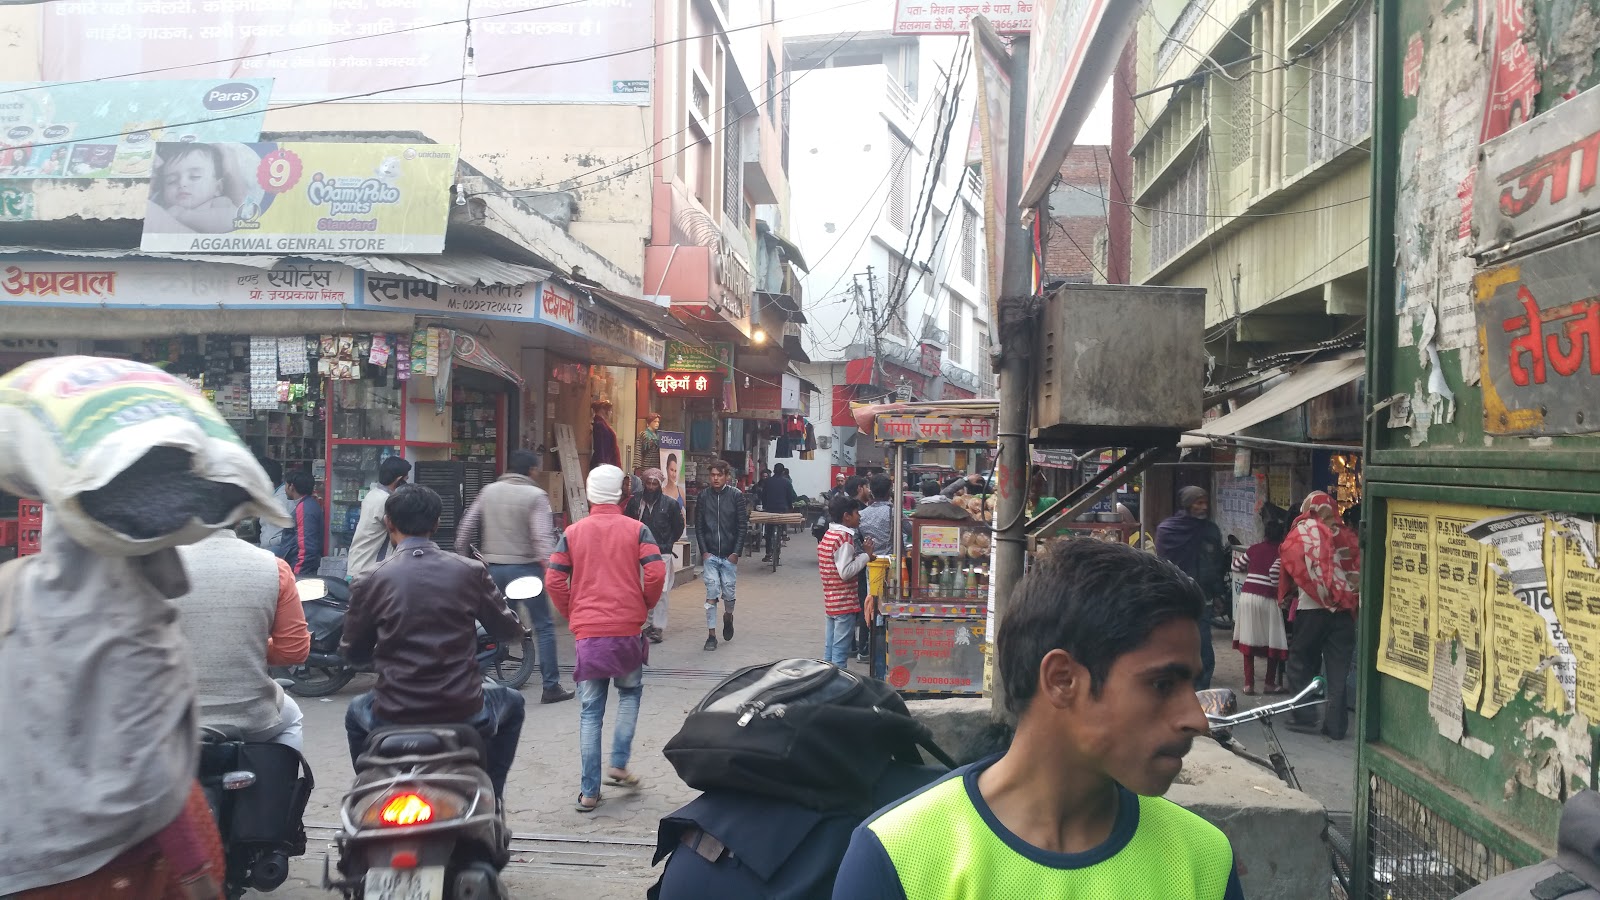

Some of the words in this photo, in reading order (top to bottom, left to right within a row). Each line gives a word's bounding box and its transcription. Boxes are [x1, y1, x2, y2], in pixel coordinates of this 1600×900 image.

[930, 3, 955, 15] मिशन
[982, 2, 991, 14] के
[899, 21, 931, 30] सलमान
[208, 90, 249, 103] Paras
[418, 151, 450, 159] unicharm
[268, 157, 291, 187] 9
[308, 174, 400, 206] MamyPoko
[330, 202, 372, 216] pants
[317, 218, 378, 232] Standard
[190, 238, 273, 251] AGGARWAL
[277, 238, 336, 251] GENRAL
[338, 238, 386, 251] STORE
[2, 265, 118, 297] अग्रवाल
[695, 376, 707, 390] ही
[884, 419, 912, 436] गंगा
[919, 423, 953, 437] सरन
[1448, 537, 1467, 547] CLASSES
[1439, 546, 1461, 556] COMPUTER
[1461, 549, 1479, 560] CENTER
[1566, 569, 1600, 585] COMPUTE
